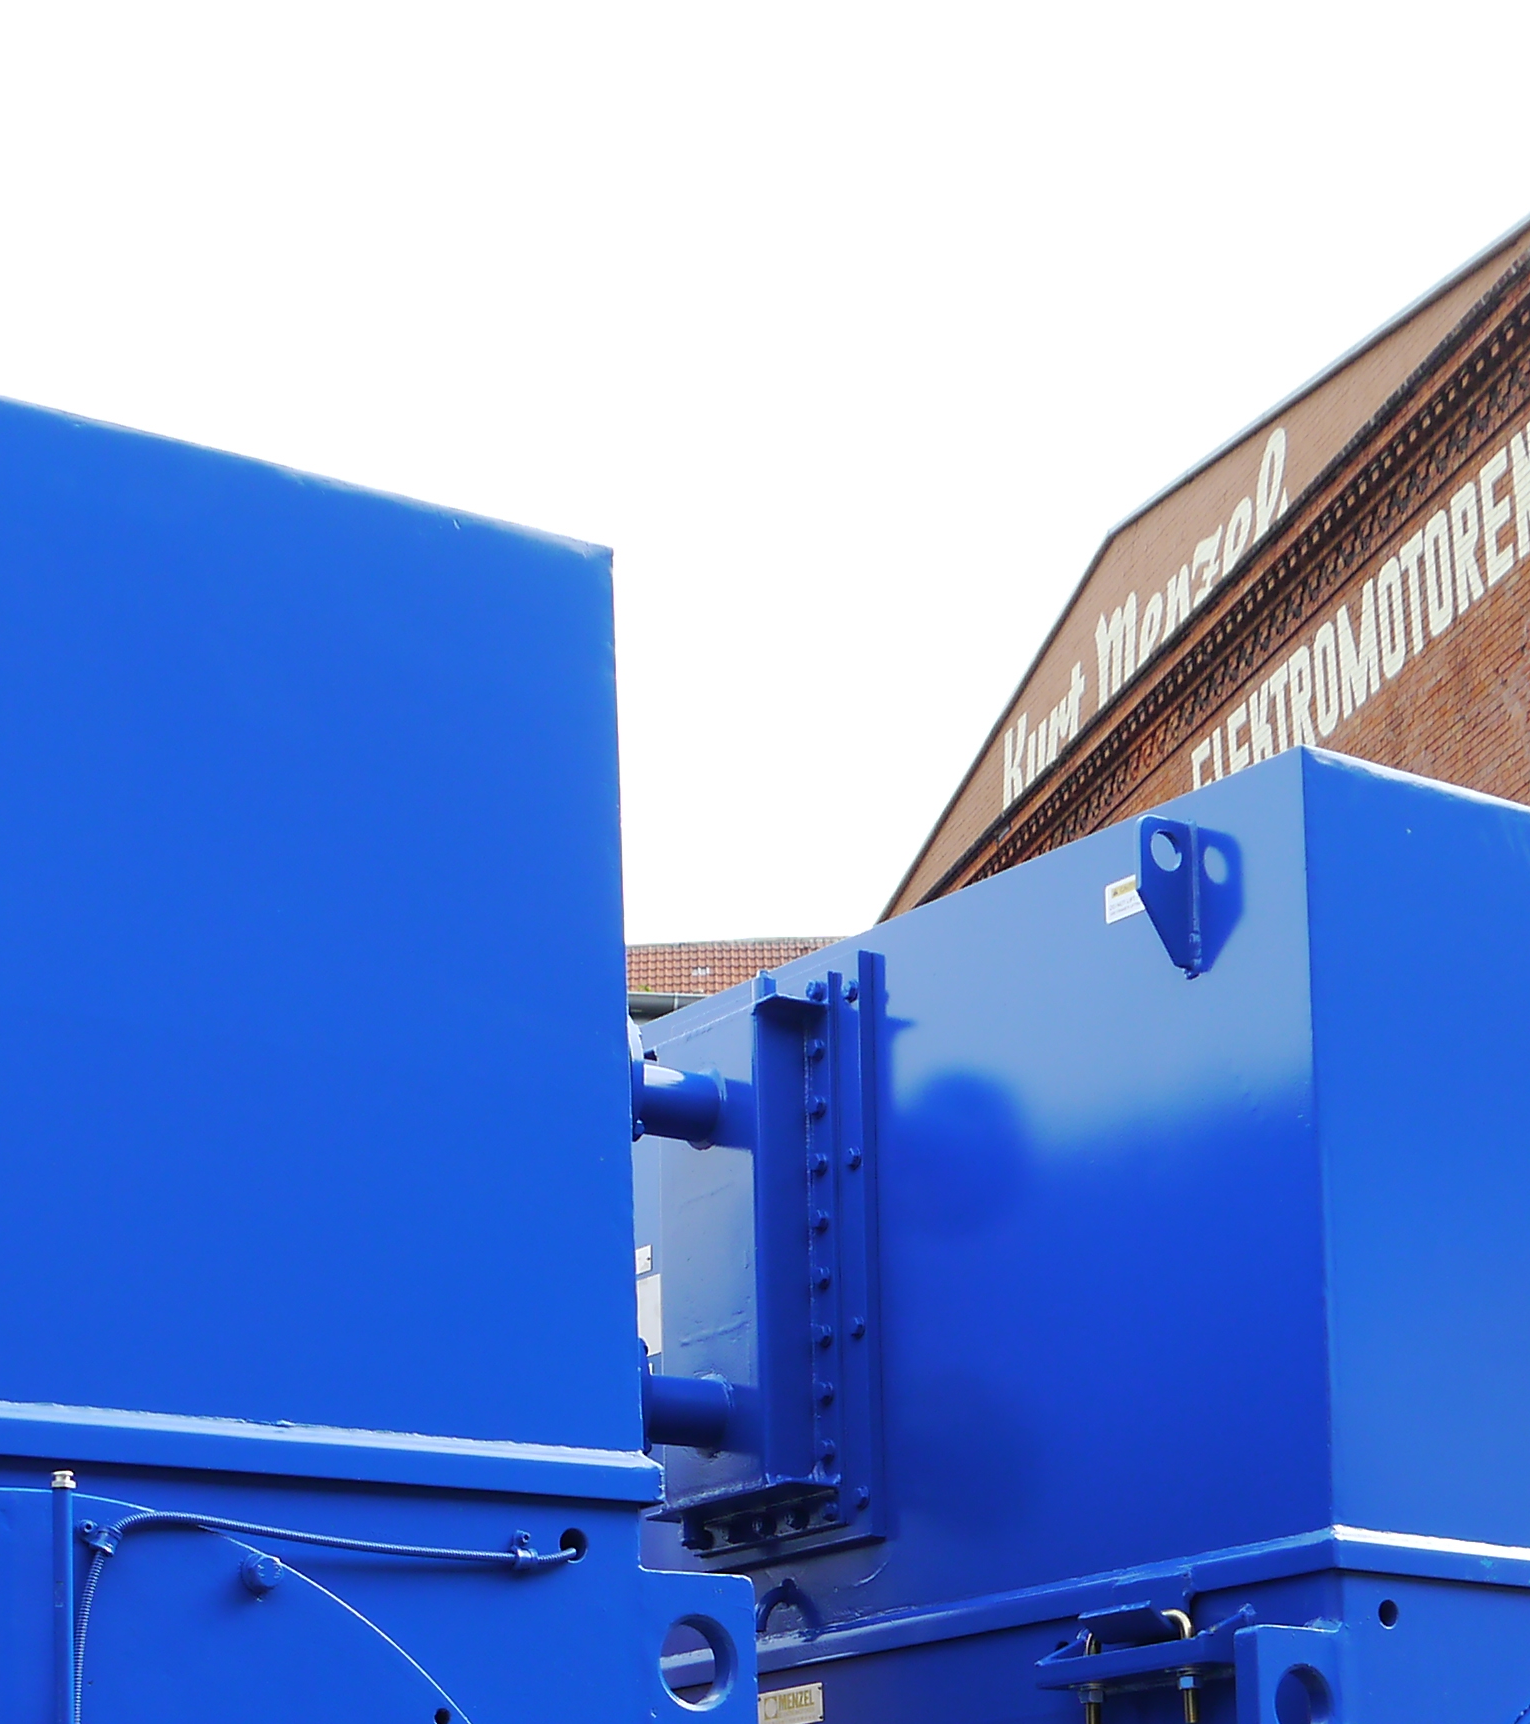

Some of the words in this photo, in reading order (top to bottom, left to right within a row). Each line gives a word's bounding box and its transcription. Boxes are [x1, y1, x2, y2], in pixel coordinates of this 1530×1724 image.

[1002, 660, 1087, 811] Kurt
[1094, 427, 1289, 711] Menzel
[779, 1689, 815, 1711] MENZEL
